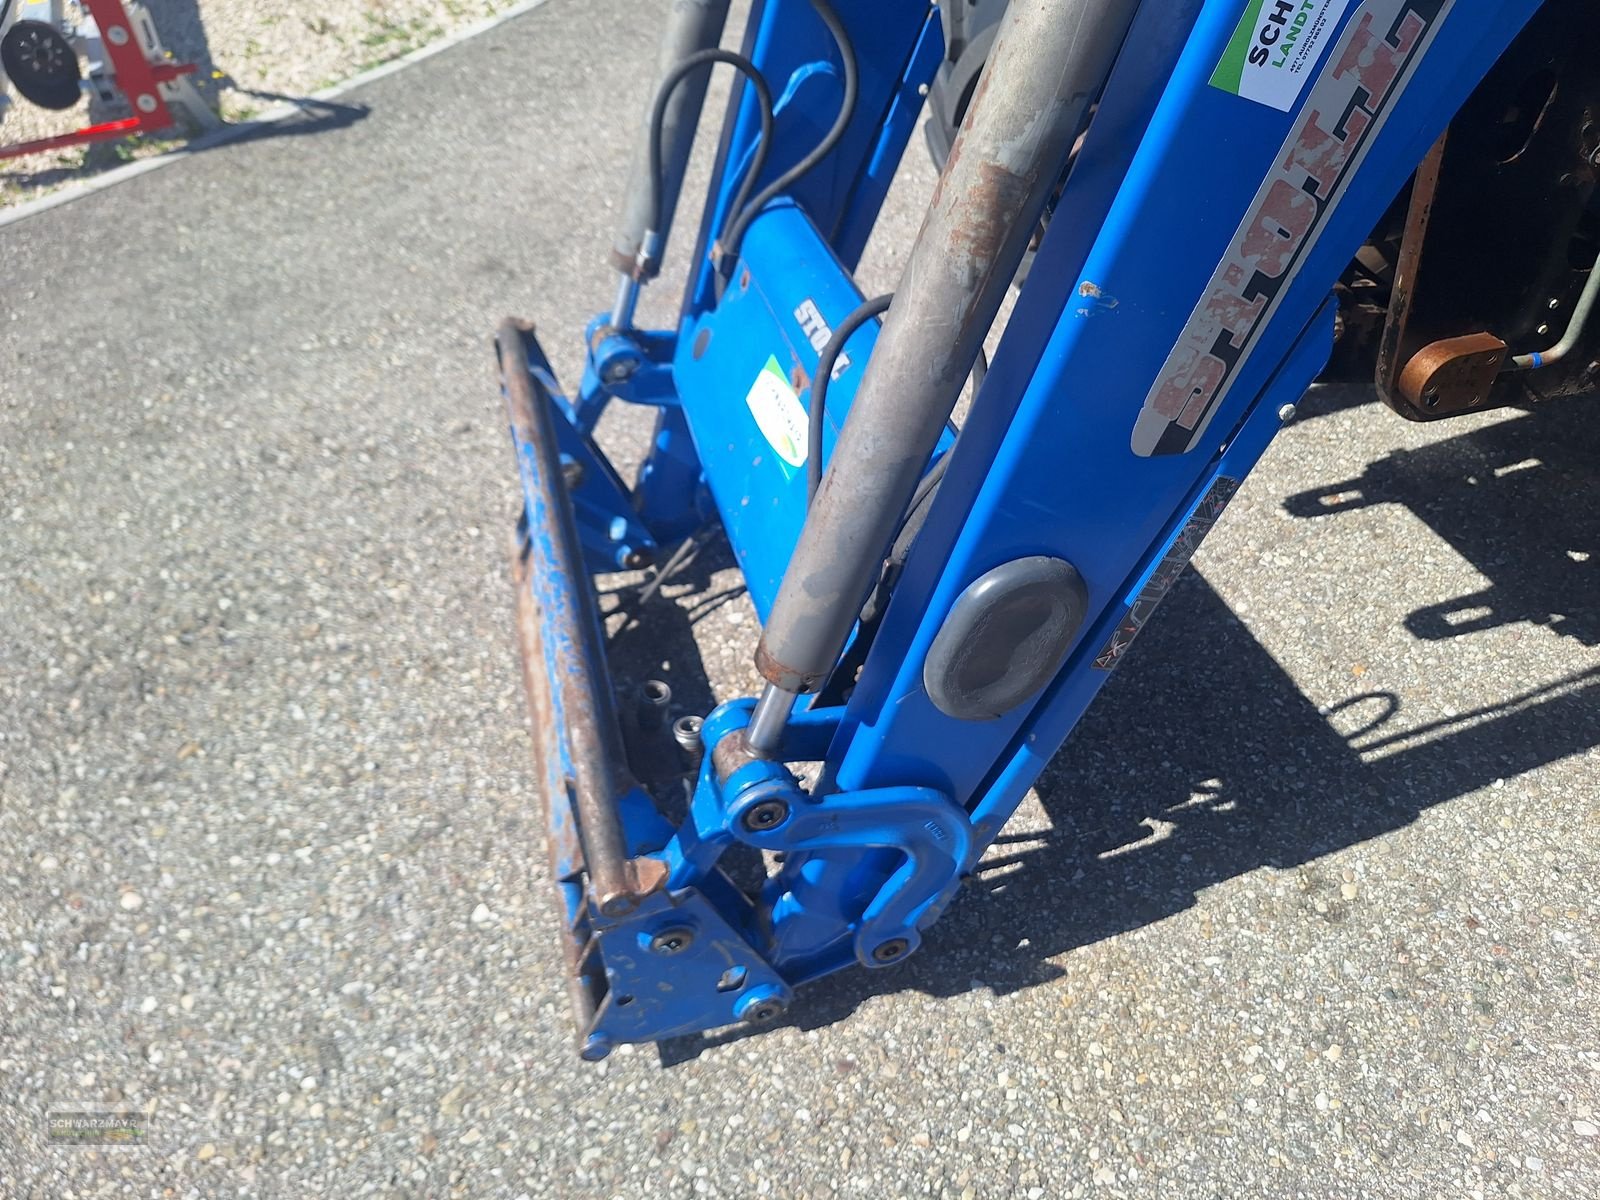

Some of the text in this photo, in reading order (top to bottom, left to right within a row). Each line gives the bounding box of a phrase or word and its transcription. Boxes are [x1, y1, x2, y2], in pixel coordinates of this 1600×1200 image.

[1290, 57, 1300, 73] 4971
[1302, 40, 1315, 60] 07752
[1313, 28, 1322, 40] 865
[1319, 18, 1327, 27] 02
[1151, 8, 1427, 430] STOLL
[793, 298, 851, 381] STOL
